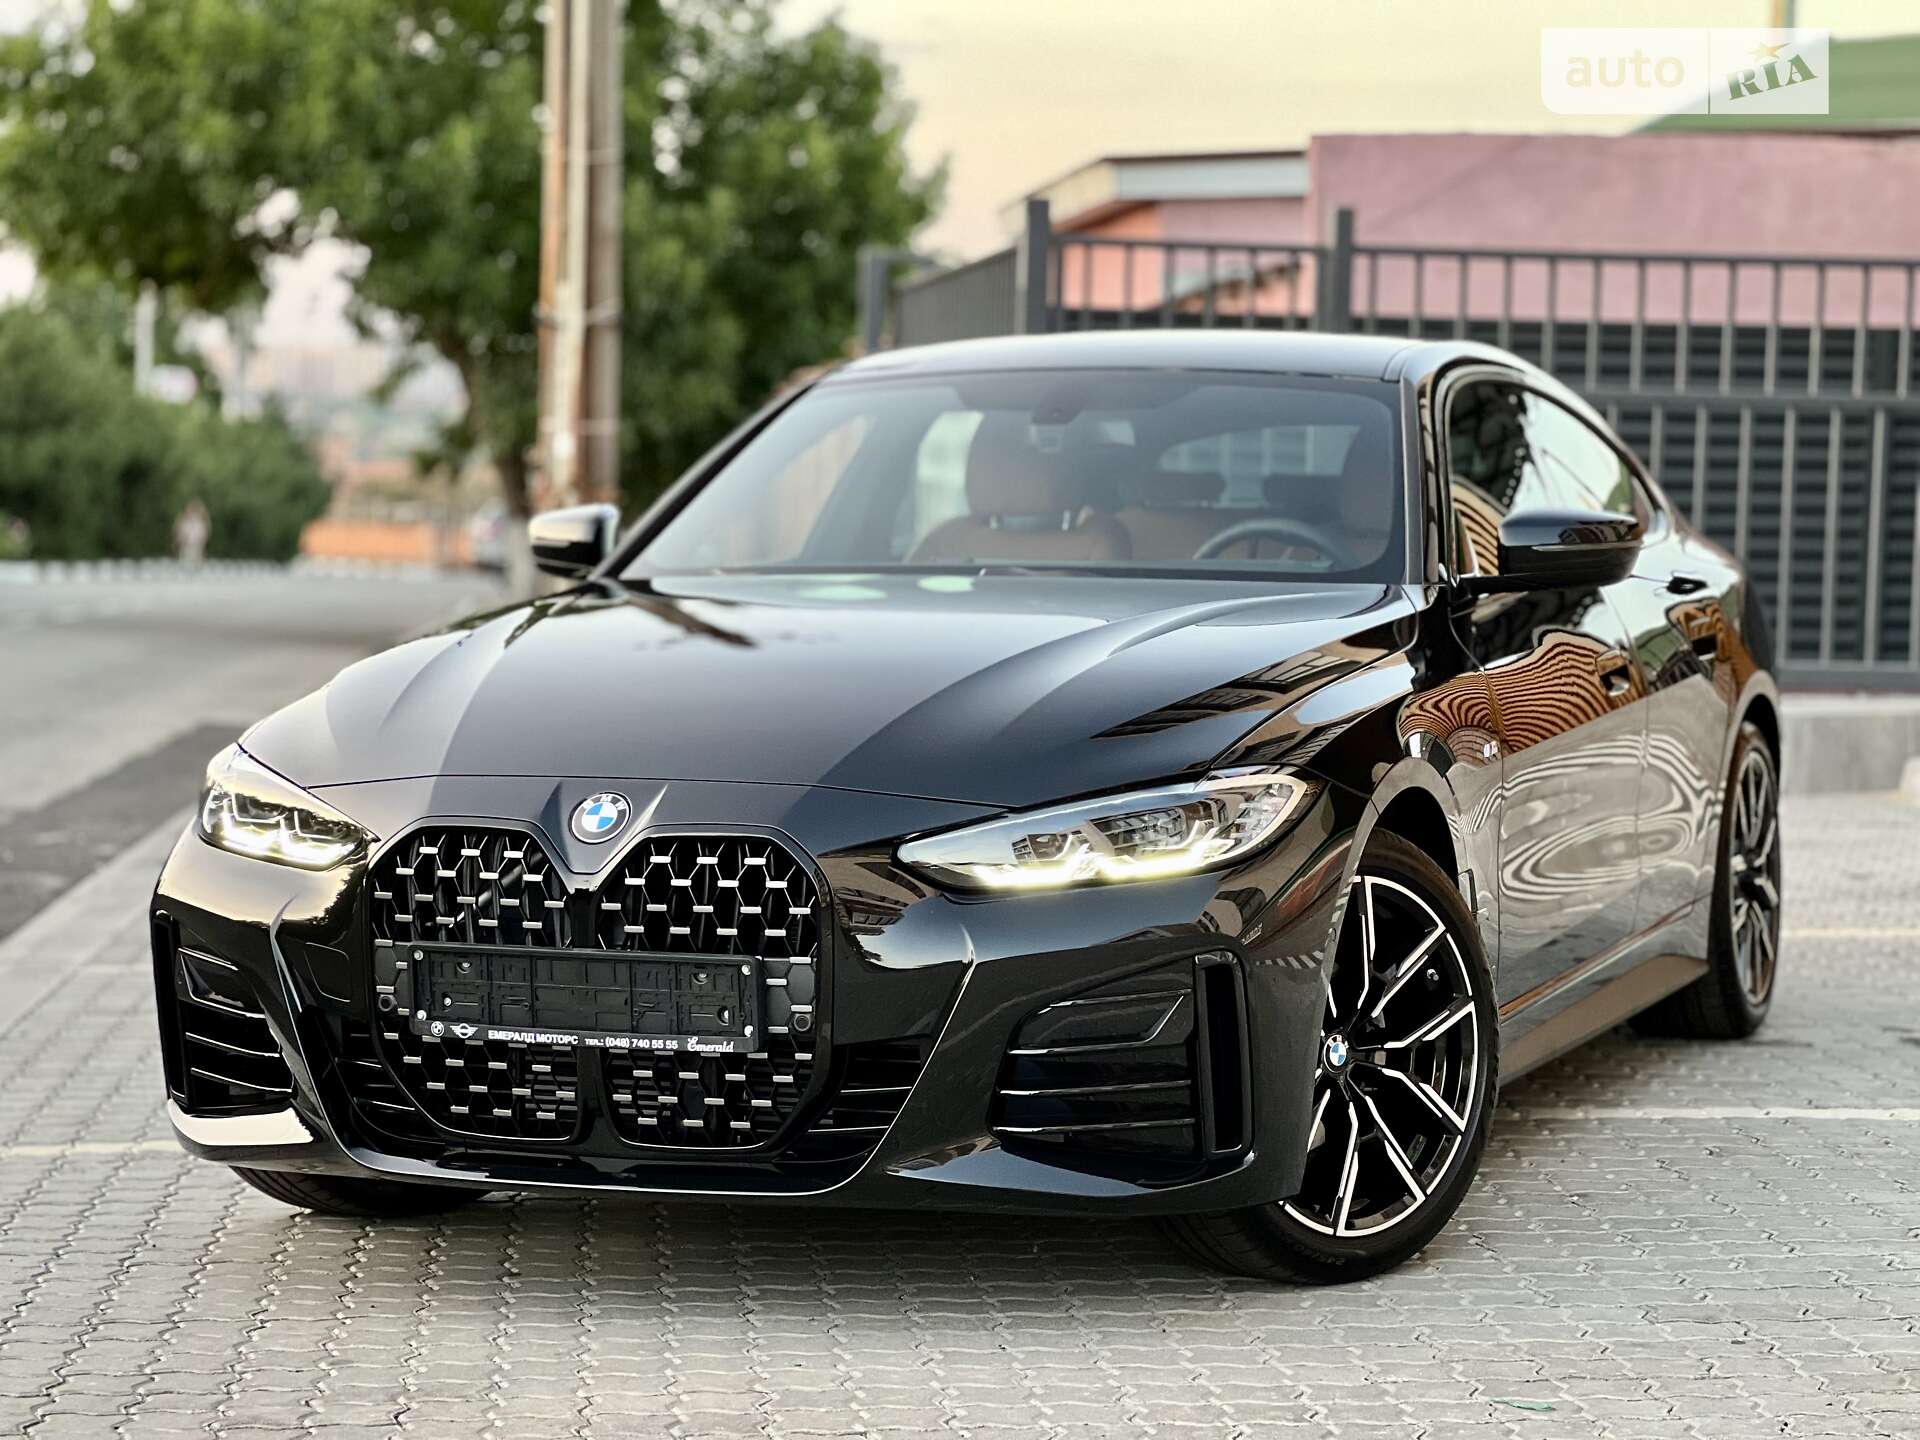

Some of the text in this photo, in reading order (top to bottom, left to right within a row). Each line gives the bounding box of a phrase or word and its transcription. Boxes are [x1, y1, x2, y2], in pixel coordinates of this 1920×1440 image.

[488, 1029, 535, 1044] ЕМЕРАЛД
[536, 1033, 579, 1045] МОТОРС
[605, 1036, 630, 1048] (048)
[631, 1038, 650, 1049] 740
[651, 1039, 664, 1049] 55
[665, 1039, 679, 1050] 55
[687, 1036, 734, 1053] Emerald
